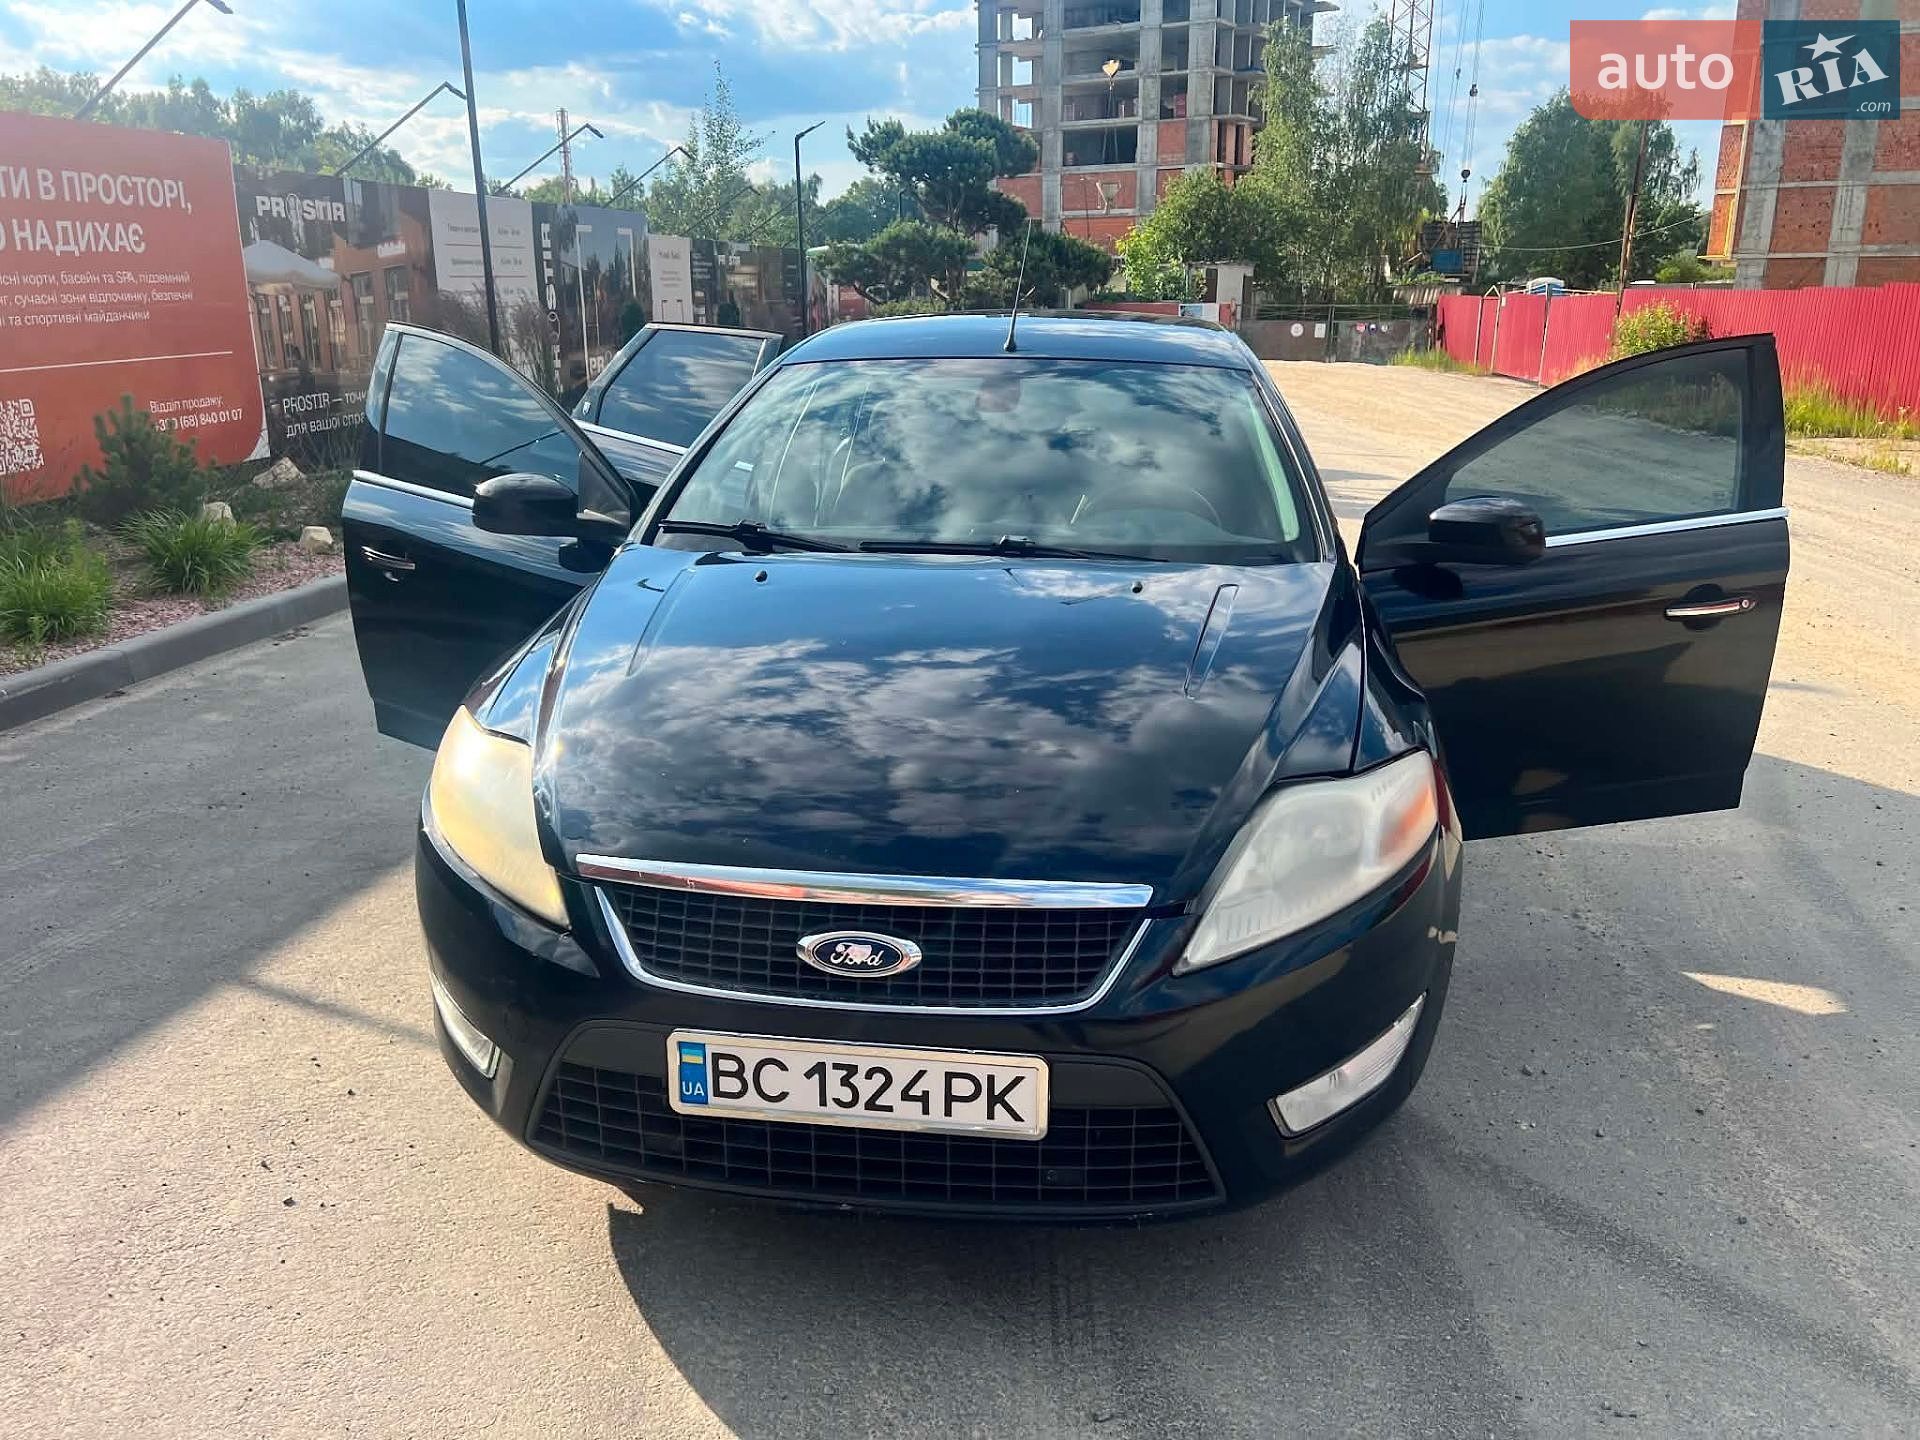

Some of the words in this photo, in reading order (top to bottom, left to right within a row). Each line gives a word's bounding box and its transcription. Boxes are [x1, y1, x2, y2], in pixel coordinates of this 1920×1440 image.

[36, 168, 56, 200] В
[61, 170, 193, 214] ПРОСТОРІ,
[12, 218, 146, 256] НАДИХАЄ
[60, 270, 100, 284] басейн
[102, 273, 115, 284] та
[14, 292, 58, 308] сучасні
[8, 315, 23, 327] та
[24, 312, 82, 328] спортивні
[85, 310, 151, 323] майданчики
[282, 392, 330, 414] PROSTIR
[180, 412, 199, 430] (68)
[199, 410, 218, 426] 840
[219, 409, 231, 423] 01
[231, 407, 243, 421] 07
[286, 421, 308, 439] для
[682, 1080, 705, 1096] UA
[710, 1052, 790, 1104] BC
[803, 1060, 931, 1117] 1324
[943, 1071, 1026, 1124] PK
